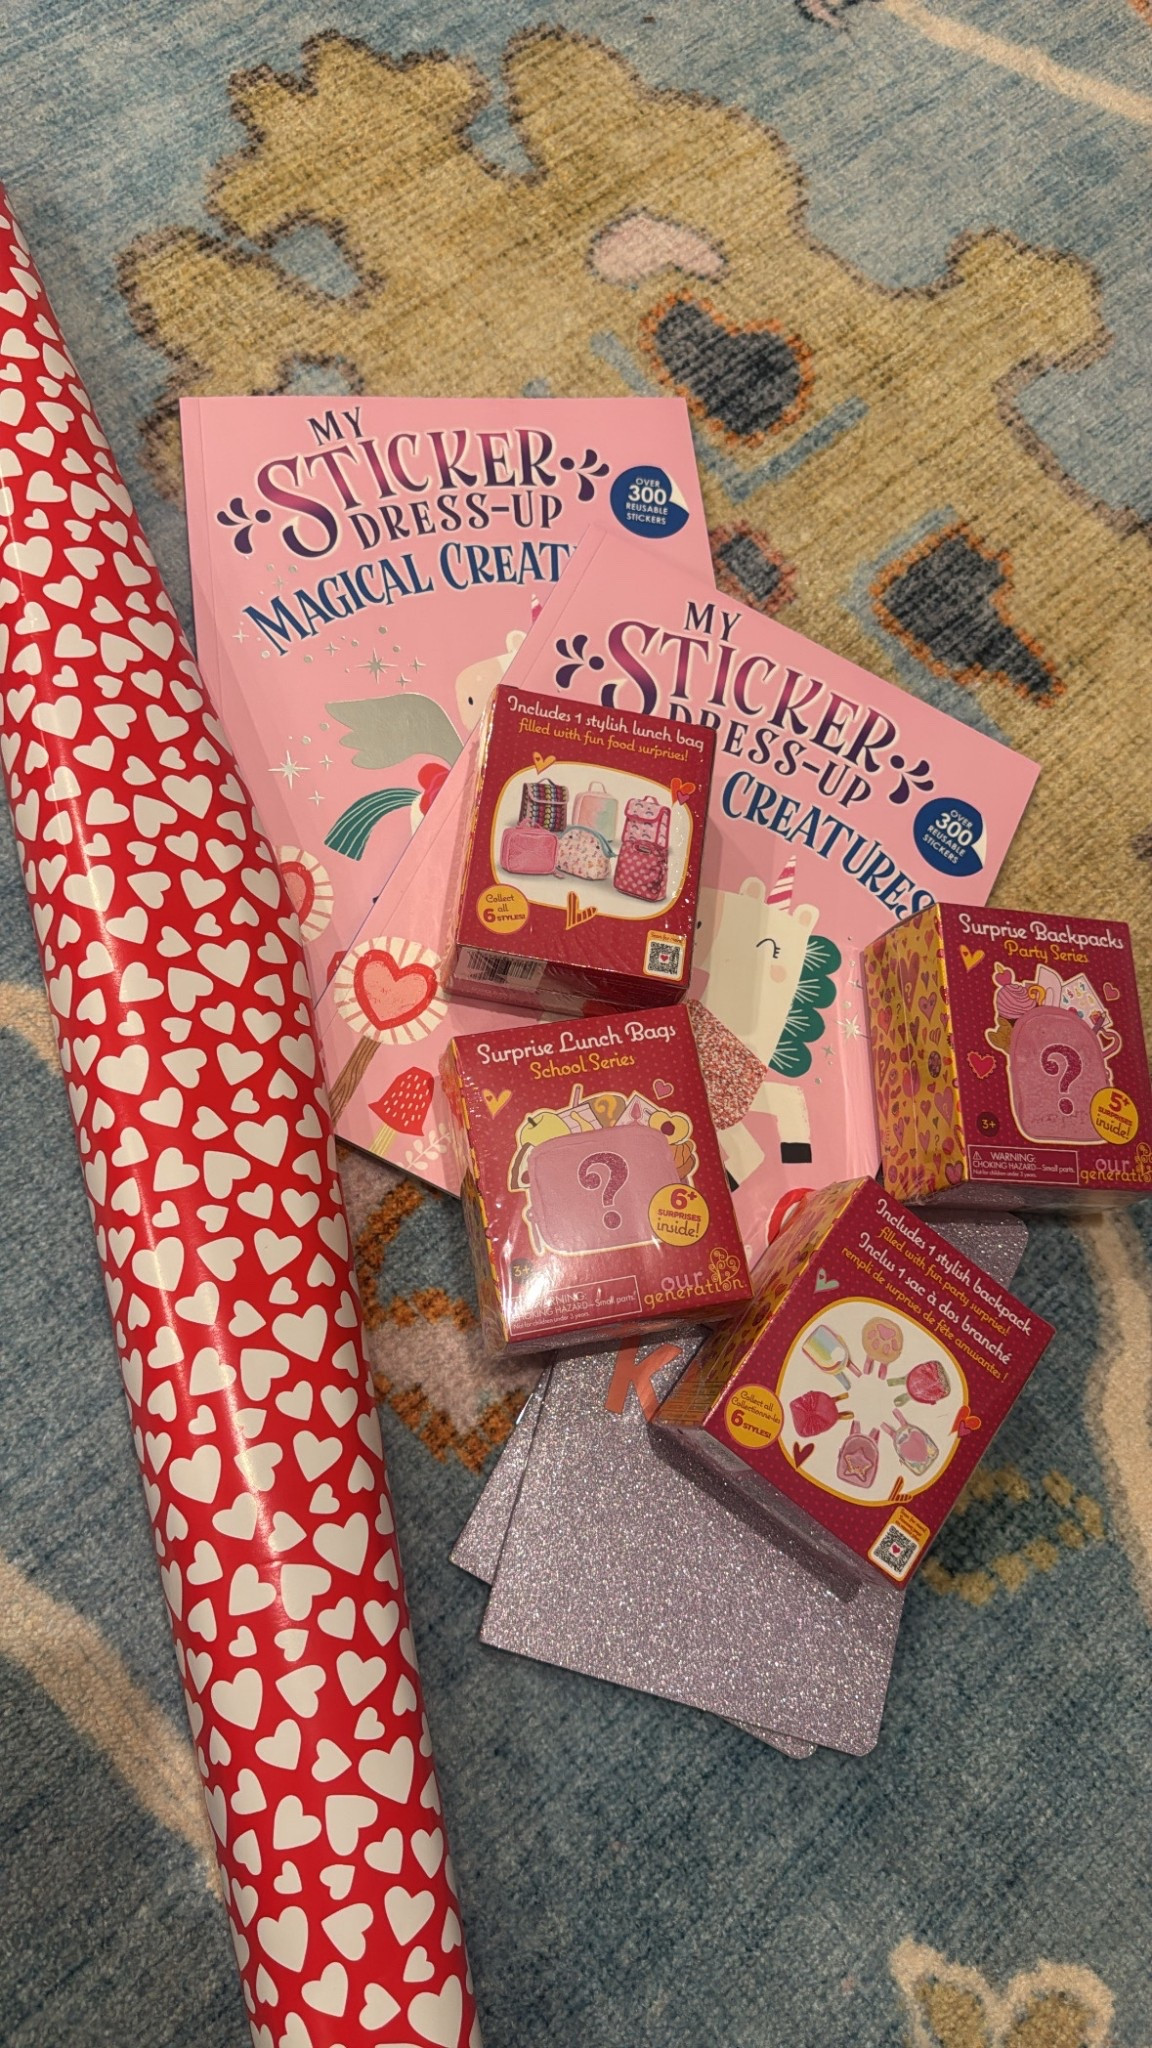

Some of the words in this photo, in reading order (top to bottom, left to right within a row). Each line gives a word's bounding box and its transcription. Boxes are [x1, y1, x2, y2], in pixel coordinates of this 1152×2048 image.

[307, 406, 363, 446] MY
[256, 428, 558, 560] STICKER
[627, 484, 667, 506] 300
[636, 477, 660, 488] OVER
[348, 488, 563, 550] DRESS-UP
[625, 502, 668, 516] REUSABLE
[626, 512, 667, 526] STICKERS
[242, 552, 434, 657] MAGICAL
[440, 542, 577, 589] CREAT
[685, 601, 741, 641] MY
[600, 620, 896, 774] STICKER
[508, 695, 571, 722] Includes
[574, 713, 582, 724] 1
[585, 715, 629, 734] stylish
[632, 720, 673, 743] lunch
[676, 729, 704, 753] bag
[518, 718, 550, 736] filled
[554, 726, 582, 741] with
[583, 731, 605, 745] fun
[607, 735, 636, 752] food
[638, 744, 689, 762] surprises!
[935, 812, 973, 846] 300
[949, 809, 973, 829] OVER
[922, 833, 959, 864] STICKERS
[927, 824, 966, 857] REUSABLE
[485, 893, 515, 903] Collect
[497, 903, 509, 912] all
[483, 908, 496, 923] 6
[958, 912, 1028, 942] Surprise
[1029, 920, 1125, 950] Backpacks
[1003, 939, 1049, 964] Party
[1050, 943, 1090, 963] Series
[477, 1040, 554, 1065] Surprise
[559, 1025, 623, 1053] Lunch
[624, 1021, 677, 1043] Bags
[530, 1054, 588, 1080] School
[588, 1052, 636, 1071] Series
[981, 1118, 997, 1130] 3+
[1095, 1113, 1131, 1140] inside!
[1097, 1105, 1133, 1127] SURPRISES
[972, 1160, 1008, 1170] CHOKING
[990, 1151, 1037, 1163] WARNING:
[1095, 1158, 1130, 1174] our
[656, 1208, 702, 1222] SURPRISES
[656, 1217, 700, 1238] inside!
[513, 1264, 530, 1277] 3+
[660, 1271, 703, 1292] our
[876, 1198, 926, 1249] Includes
[928, 1245, 936, 1256] 1
[935, 1252, 971, 1287] stylish
[972, 1277, 1031, 1337] backpack
[876, 1226, 907, 1251] filled
[904, 1249, 926, 1271] with
[924, 1265, 943, 1285] fun
[942, 1281, 970, 1307] party
[970, 1303, 1011, 1336] surprises!
[644, 1277, 744, 1310] generation
[859, 1231, 895, 1272] Inclus
[898, 1268, 906, 1279] 1
[905, 1276, 926, 1297] sac
[927, 1290, 937, 1306] à
[938, 1301, 959, 1324] dos
[961, 1316, 1013, 1365] branché
[841, 1247, 874, 1276] rempli
[872, 1271, 885, 1285] de
[885, 1281, 922, 1314] surprises
[922, 1310, 935, 1325] de
[936, 1319, 954, 1341] fête
[955, 1337, 1001, 1380] amusantes
[604, 1335, 683, 1423] K
[731, 1396, 781, 1424] Collectionne-les
[740, 1390, 763, 1407] Collect
[763, 1402, 774, 1412] all
[731, 1409, 745, 1427] 6
[742, 1422, 772, 1439] STYLES!
